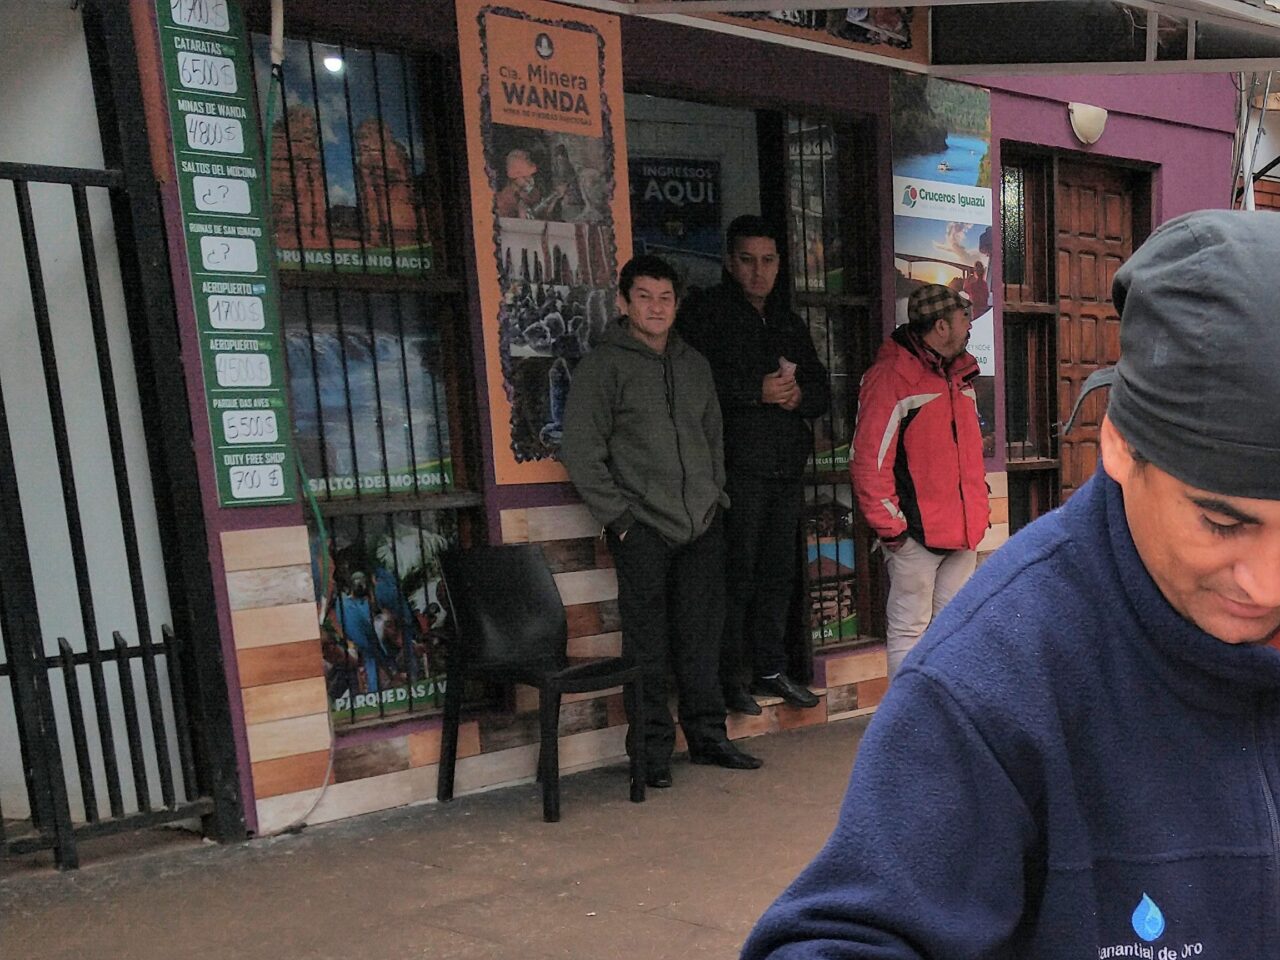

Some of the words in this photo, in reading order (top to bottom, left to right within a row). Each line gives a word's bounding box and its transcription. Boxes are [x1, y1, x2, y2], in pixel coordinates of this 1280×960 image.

[174, 36, 222, 55] CATARATAS
[528, 63, 588, 91] Minera
[501, 81, 590, 116] WANDA
[178, 99, 204, 114] MINAS
[205, 101, 217, 115] DE
[217, 104, 247, 119] WANDA
[181, 161, 211, 174] SALTOS
[211, 164, 226, 176] DEL
[642, 166, 713, 178] INGRESSOS
[644, 179, 714, 206] AQUI
[919, 188, 956, 203] Cruceros
[958, 193, 985, 207] Iguazú
[223, 225, 237, 235] SAN
[202, 282, 252, 294] AEROPUERTO
[210, 338, 259, 350] AEROPUERTO
[223, 454, 244, 466] DUTY
[245, 453, 264, 465] FREE
[264, 452, 285, 463] SHOP
[1098, 943, 1153, 960] anantial
[1157, 947, 1178, 960] de
